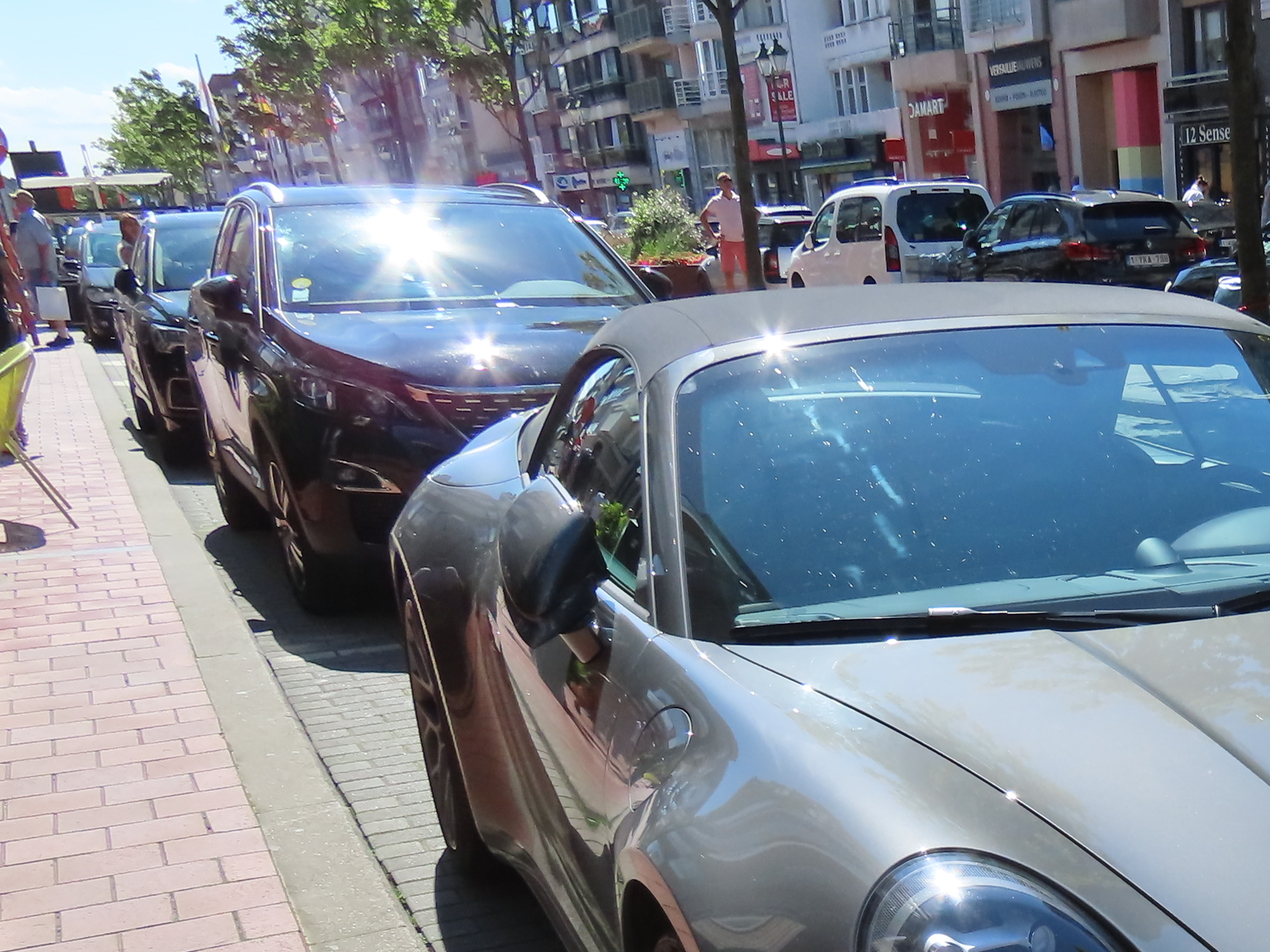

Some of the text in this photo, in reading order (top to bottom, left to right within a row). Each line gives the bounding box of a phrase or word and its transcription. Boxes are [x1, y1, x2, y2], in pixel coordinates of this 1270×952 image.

[908, 98, 946, 119] DAMART
[1185, 123, 1231, 144] 12 Sense
